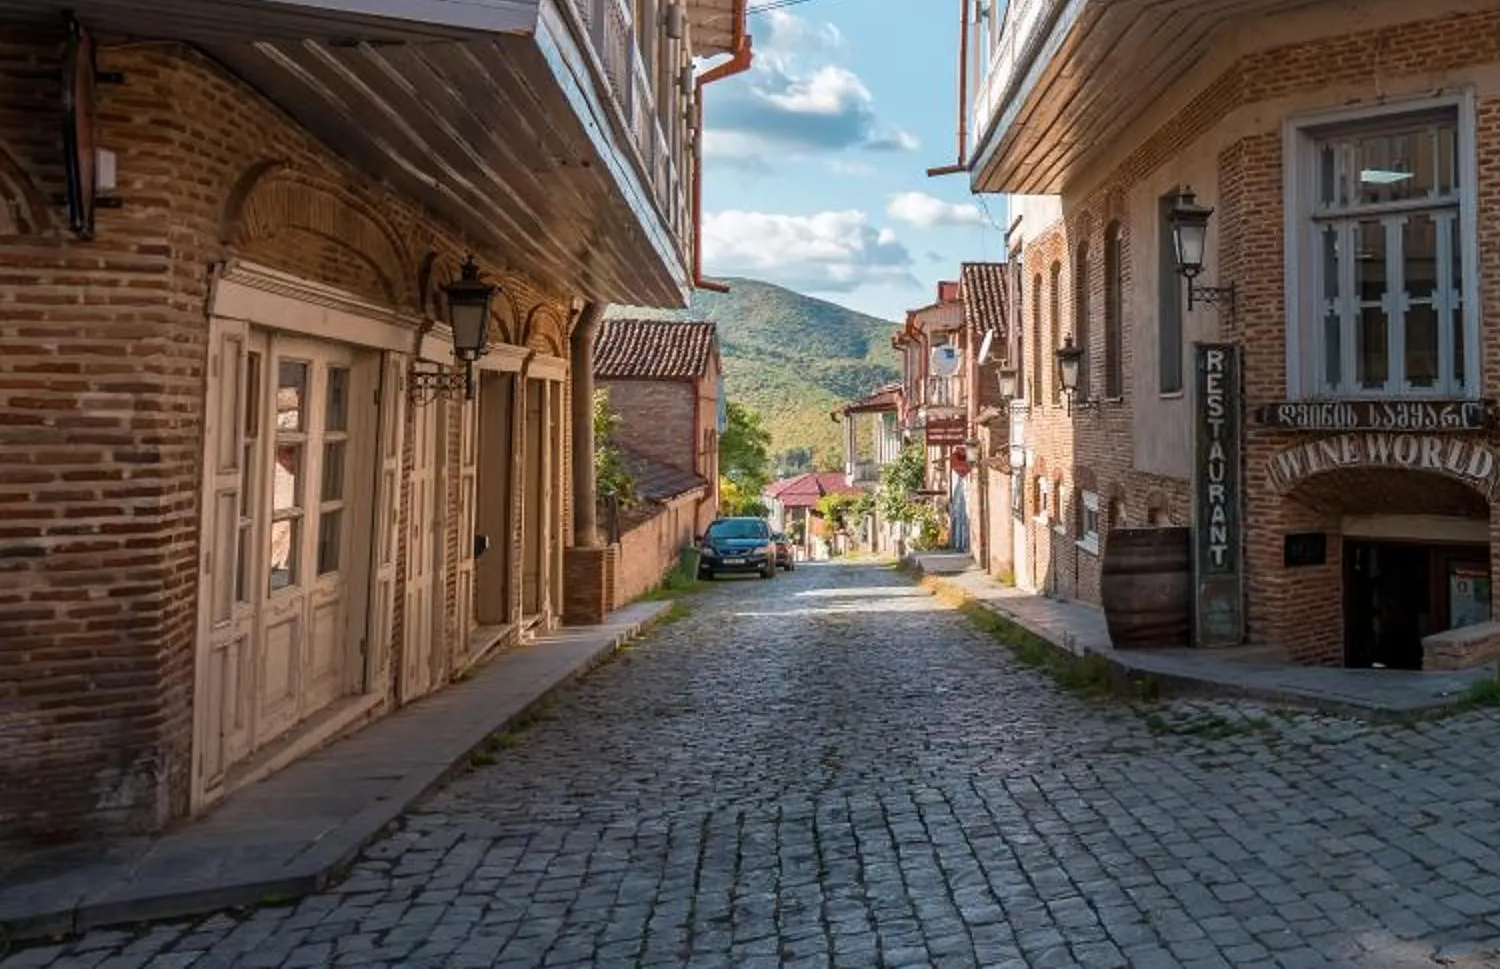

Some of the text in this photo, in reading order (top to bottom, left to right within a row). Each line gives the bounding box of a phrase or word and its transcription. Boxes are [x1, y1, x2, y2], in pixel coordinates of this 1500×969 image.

[1206, 349, 1228, 566] RESTAURANT
[1276, 432, 1494, 480] WINE WORLD
